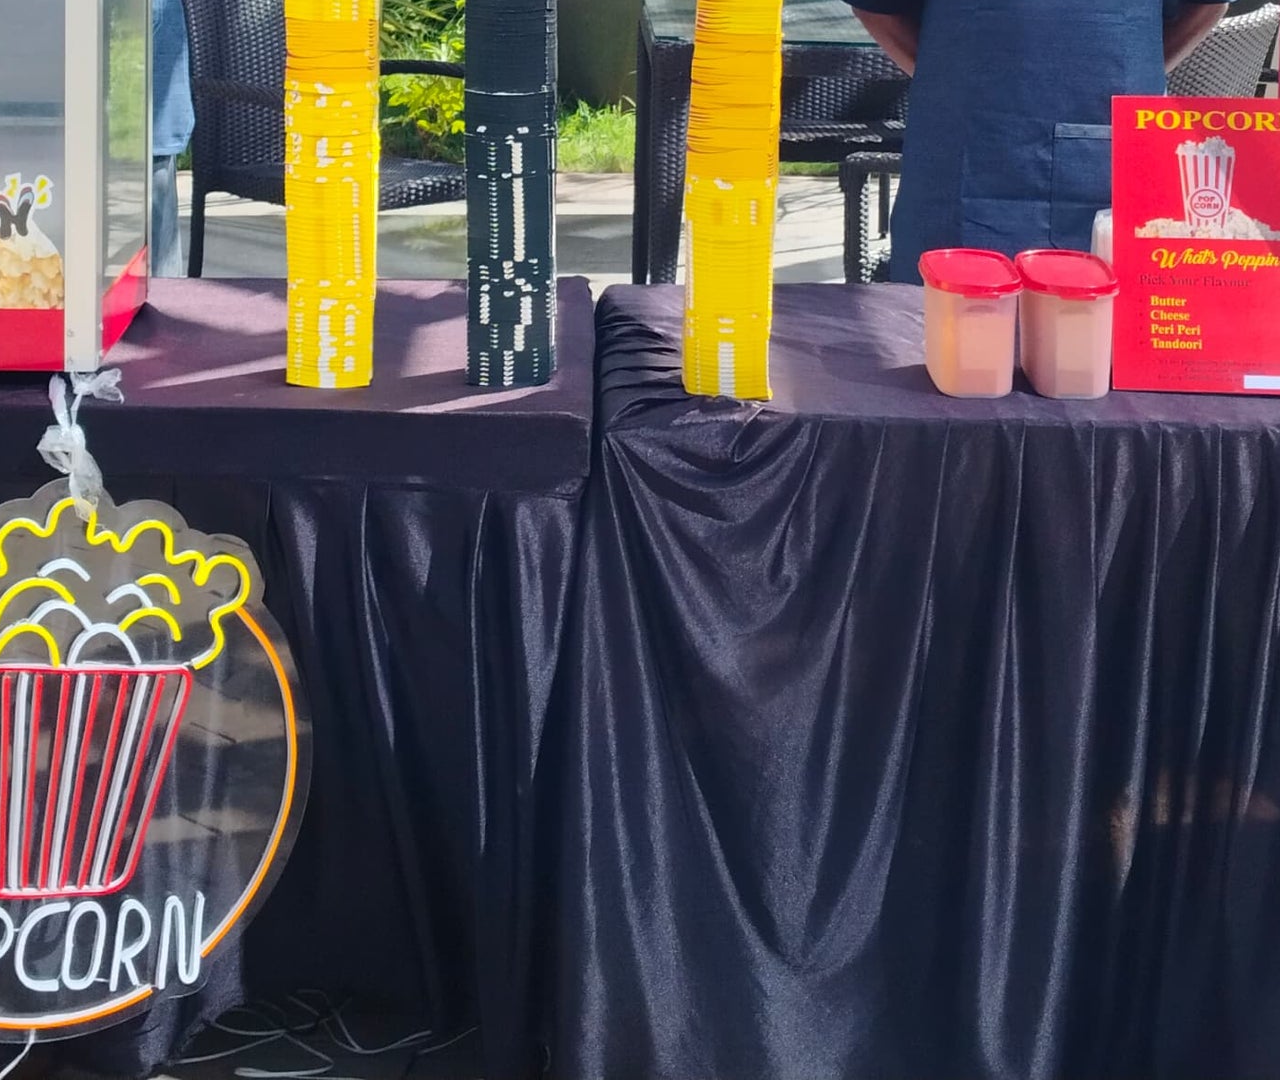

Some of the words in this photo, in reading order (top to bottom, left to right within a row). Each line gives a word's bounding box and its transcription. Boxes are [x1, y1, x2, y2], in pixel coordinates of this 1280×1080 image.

[1193, 202, 1220, 210] CORN
[1151, 248, 1219, 269] What's
[1139, 274, 1166, 286] Pick
[1169, 275, 1200, 286] Your
[1203, 276, 1252, 288] Flavour
[1150, 295, 1187, 307] Butter
[1150, 309, 1190, 321] Cheese
[1150, 324, 1174, 335] Peri
[1177, 325, 1201, 336] Peri
[1150, 338, 1203, 350] Tandoori
